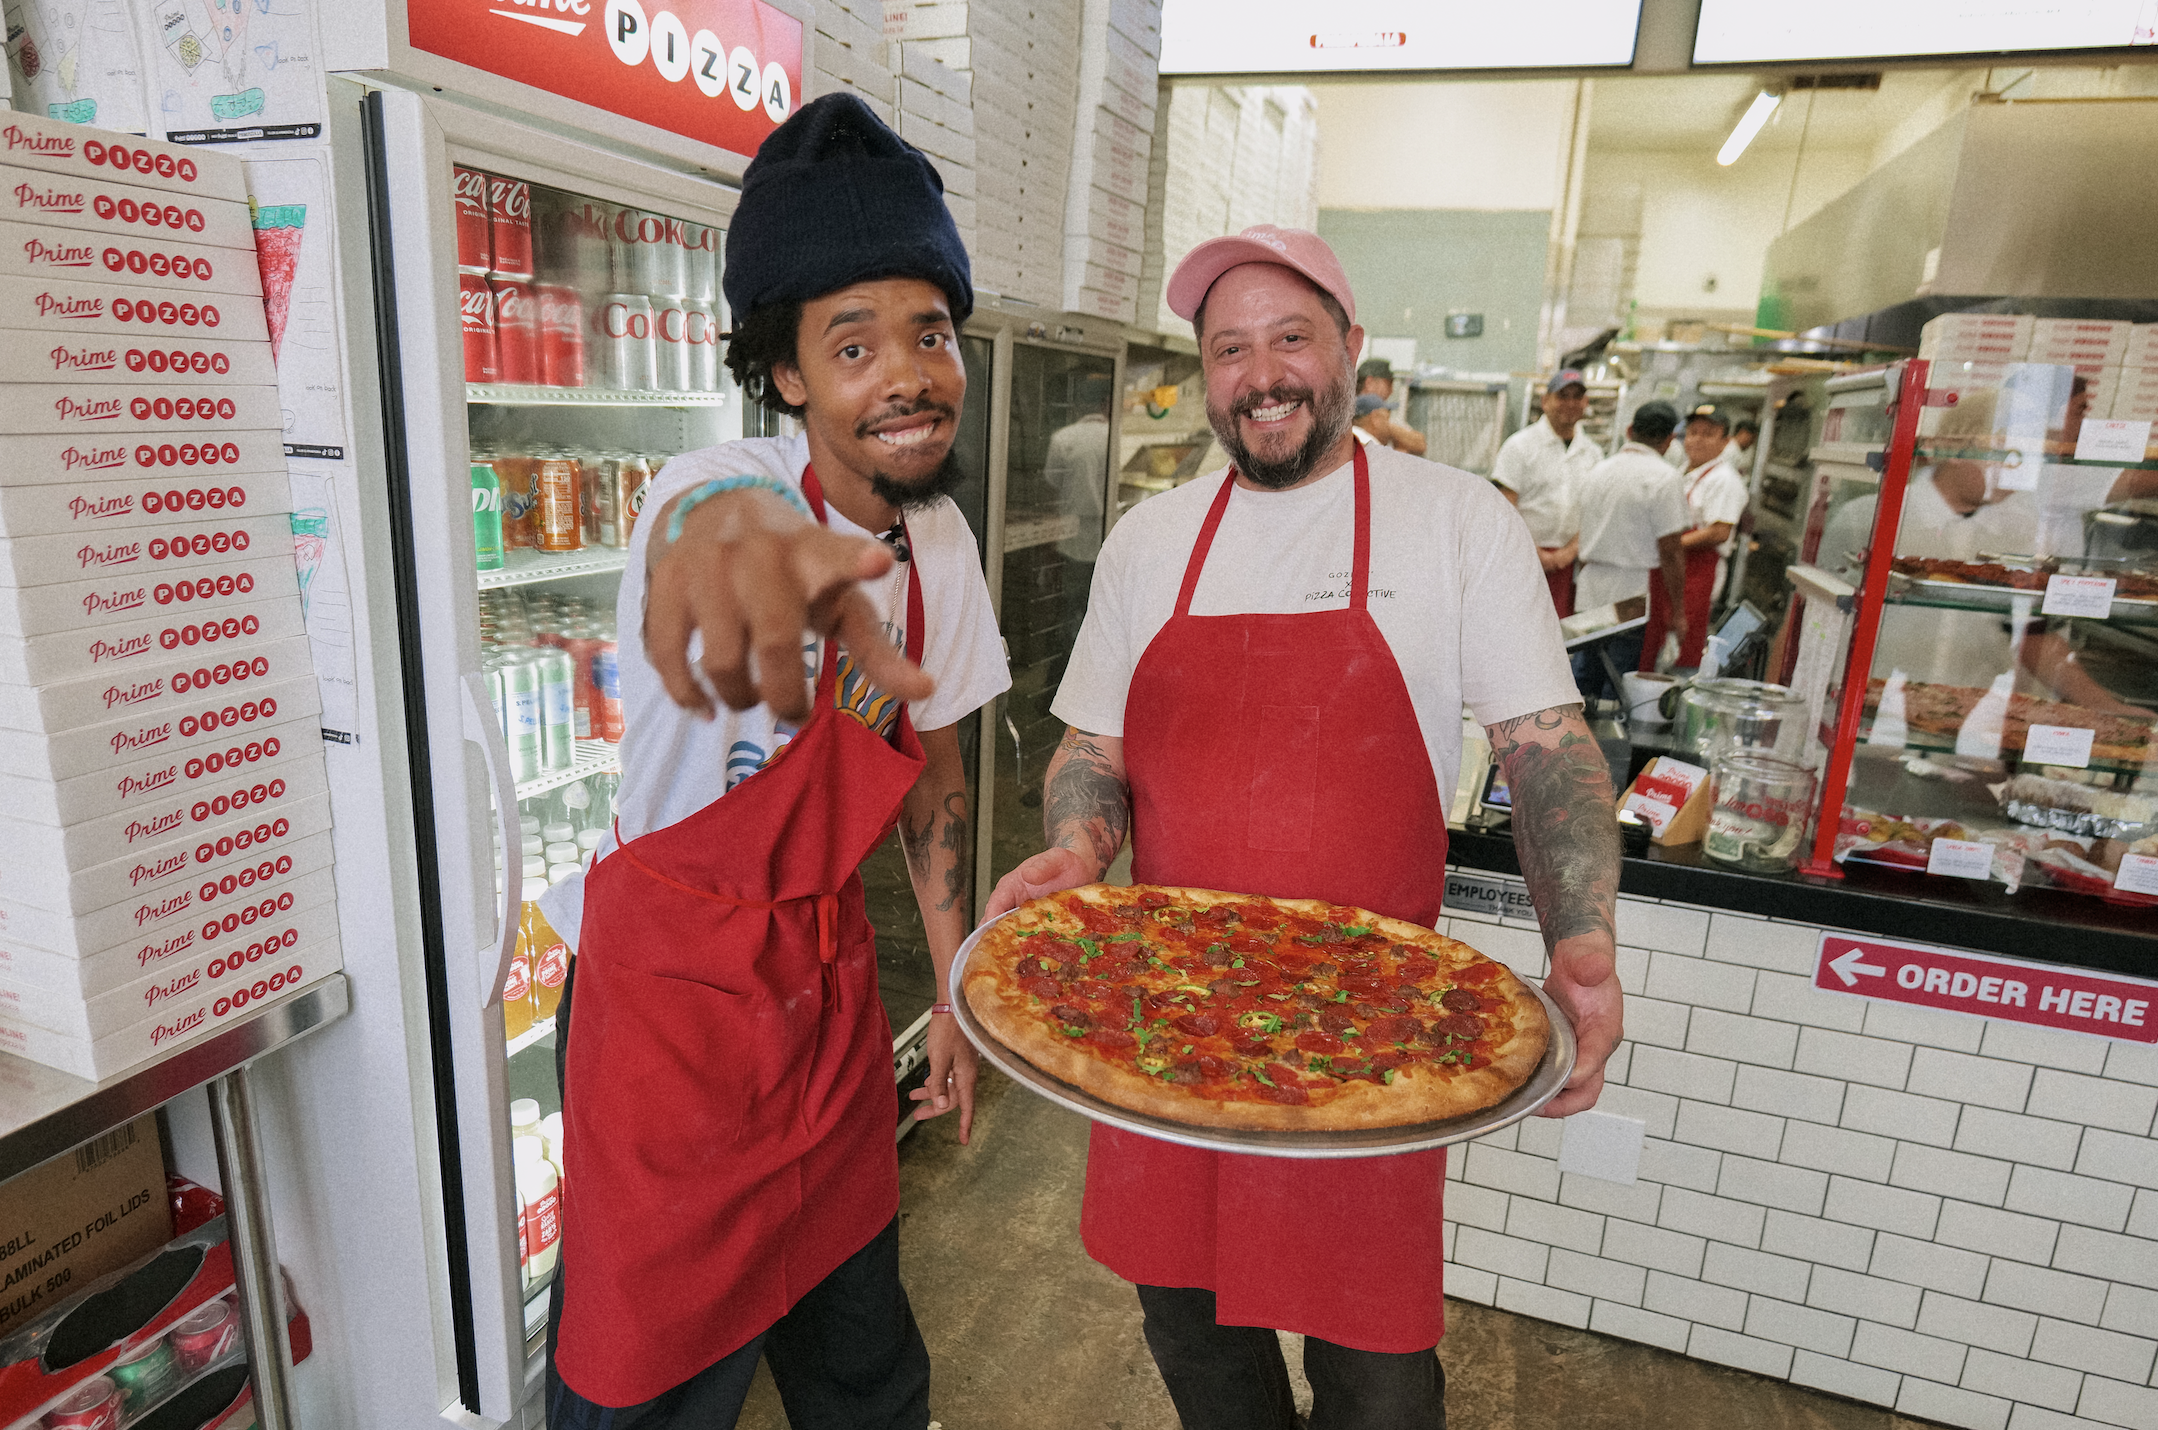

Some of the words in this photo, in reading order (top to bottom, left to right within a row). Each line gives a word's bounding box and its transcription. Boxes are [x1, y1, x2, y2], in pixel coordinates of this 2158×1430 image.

[884, 13, 908, 23] LINE!
[609, 3, 788, 119] PIZZA
[2, 124, 76, 158] Prime
[85, 142, 196, 180] PIZZA
[13, 182, 86, 213] Prime
[95, 197, 203, 230] PIZZA
[23, 238, 95, 267] Prime
[104, 249, 211, 279] PIZZA
[34, 291, 105, 319] Prime
[114, 300, 218, 325] PIZZA
[49, 345, 118, 371] Prime
[127, 351, 228, 372] PIZZA
[54, 396, 123, 420] Prime
[132, 399, 234, 418] PIZZA
[60, 446, 128, 470] Prime
[136, 444, 238, 465] PIZZA
[68, 494, 135, 519] Prime
[143, 488, 244, 512] PIZZA
[76, 541, 140, 568] Prime
[150, 532, 248, 558] PIZZA
[82, 587, 146, 615] Prime
[156, 575, 252, 603] PIZZA
[88, 633, 152, 662] Prime
[162, 617, 257, 647] PIZZA
[102, 678, 164, 708] Prime
[174, 659, 267, 691] PIZZA
[109, 722, 171, 754] Prime
[181, 700, 275, 734] PIZZA
[117, 765, 177, 798] Prime
[186, 739, 278, 776] PIZZA
[124, 808, 184, 843] Prime
[192, 781, 284, 819] PIZZA
[1645, 787, 1674, 803] Prime
[129, 851, 188, 886] Prime
[197, 820, 287, 861] PIZZA
[134, 890, 193, 926] Prime
[201, 857, 290, 900] PIZZA
[1448, 882, 1533, 907] EMPLOYEES
[1488, 903, 1514, 913] THANK
[1516, 908, 1534, 917] YOU
[137, 929, 195, 966] Prime
[203, 894, 292, 938] PIZZA
[144, 968, 201, 1006] Prime
[209, 930, 296, 976] PIZZA
[0, 988, 21, 1002] LINE!
[149, 1007, 207, 1046] Prime
[215, 967, 298, 1015] PIZZA
[1896, 963, 2029, 1008] ORDER
[2038, 985, 2150, 1027] HERE
[0, 1026, 28, 1042] NLINE!
[85, 1211, 118, 1239] FOIL
[120, 1188, 151, 1218] LIDS
[0, 1285, 43, 1323] BULK
[46, 1267, 72, 1293] 500
